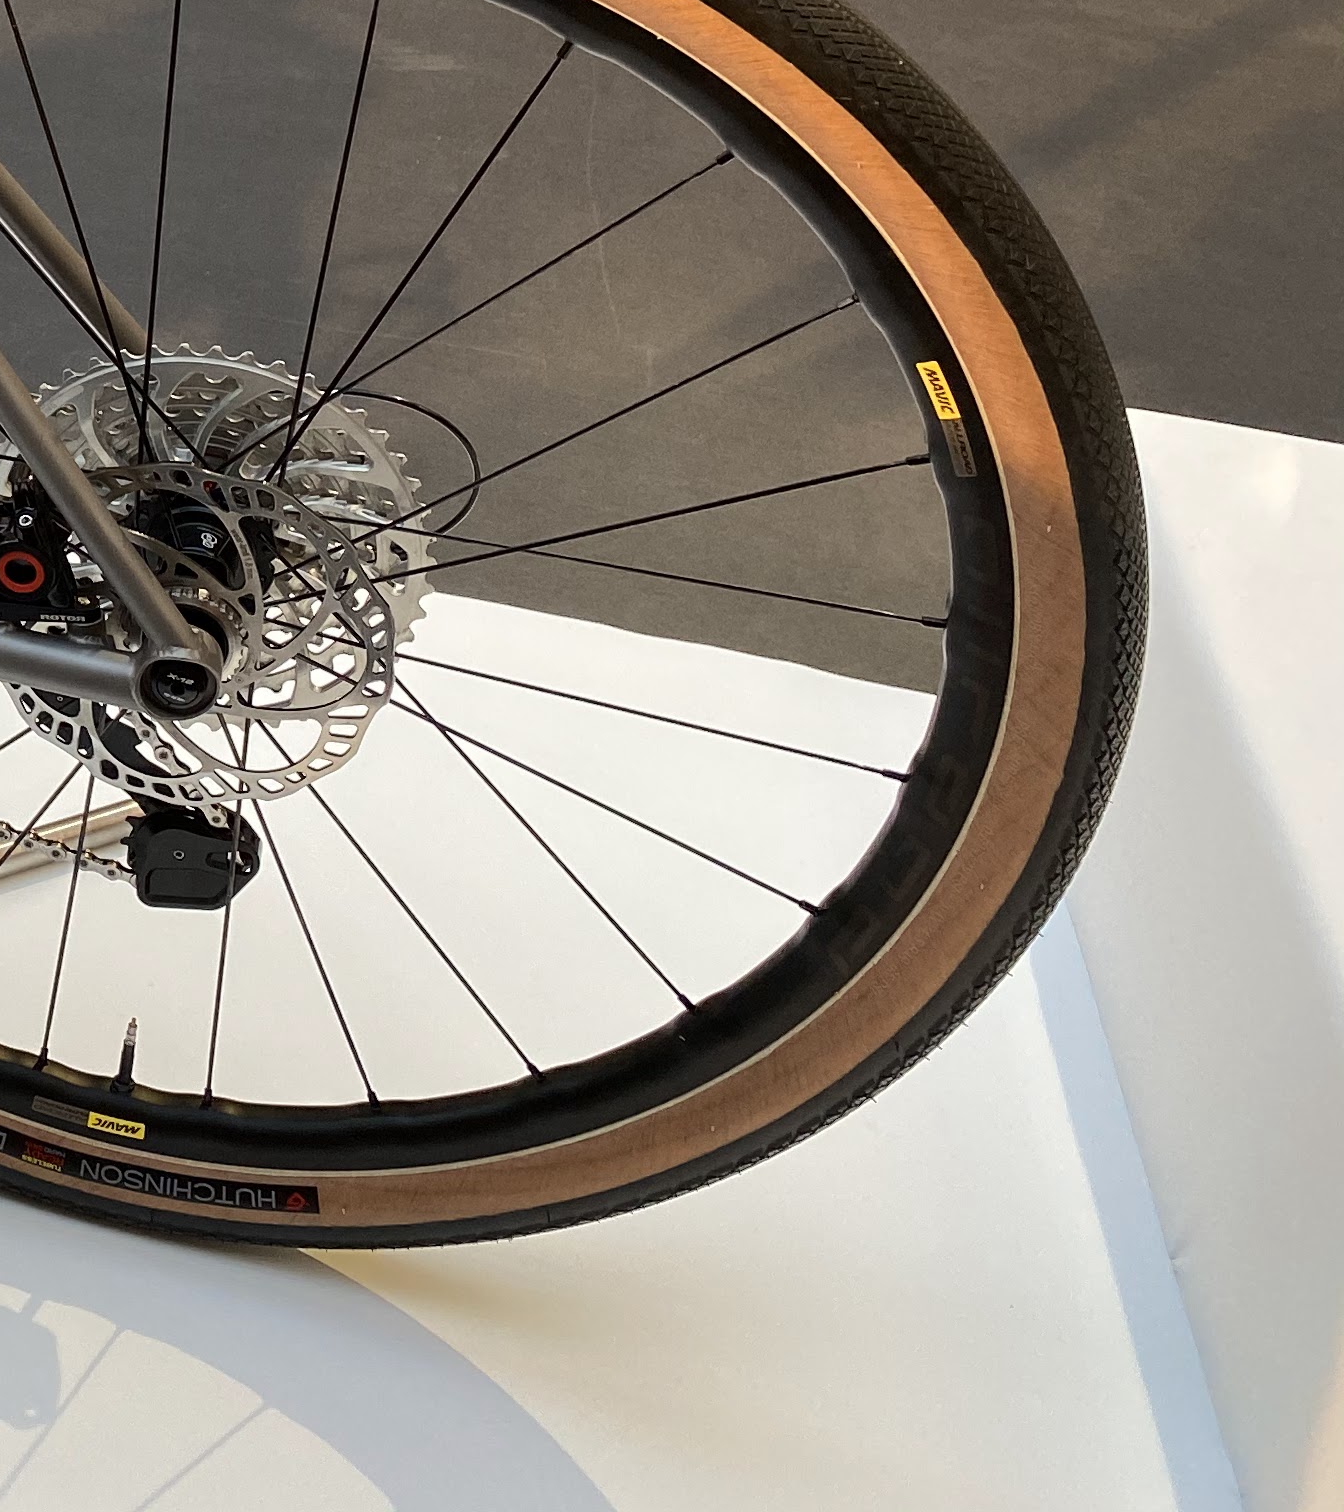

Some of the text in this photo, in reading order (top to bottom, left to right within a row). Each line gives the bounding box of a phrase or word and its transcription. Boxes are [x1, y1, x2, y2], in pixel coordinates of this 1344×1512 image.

[923, 367, 955, 415] MAVIC
[40, 614, 86, 622] ROTOR
[92, 1117, 142, 1135] MAVIC
[80, 1158, 277, 1209] HUTCHINSON
